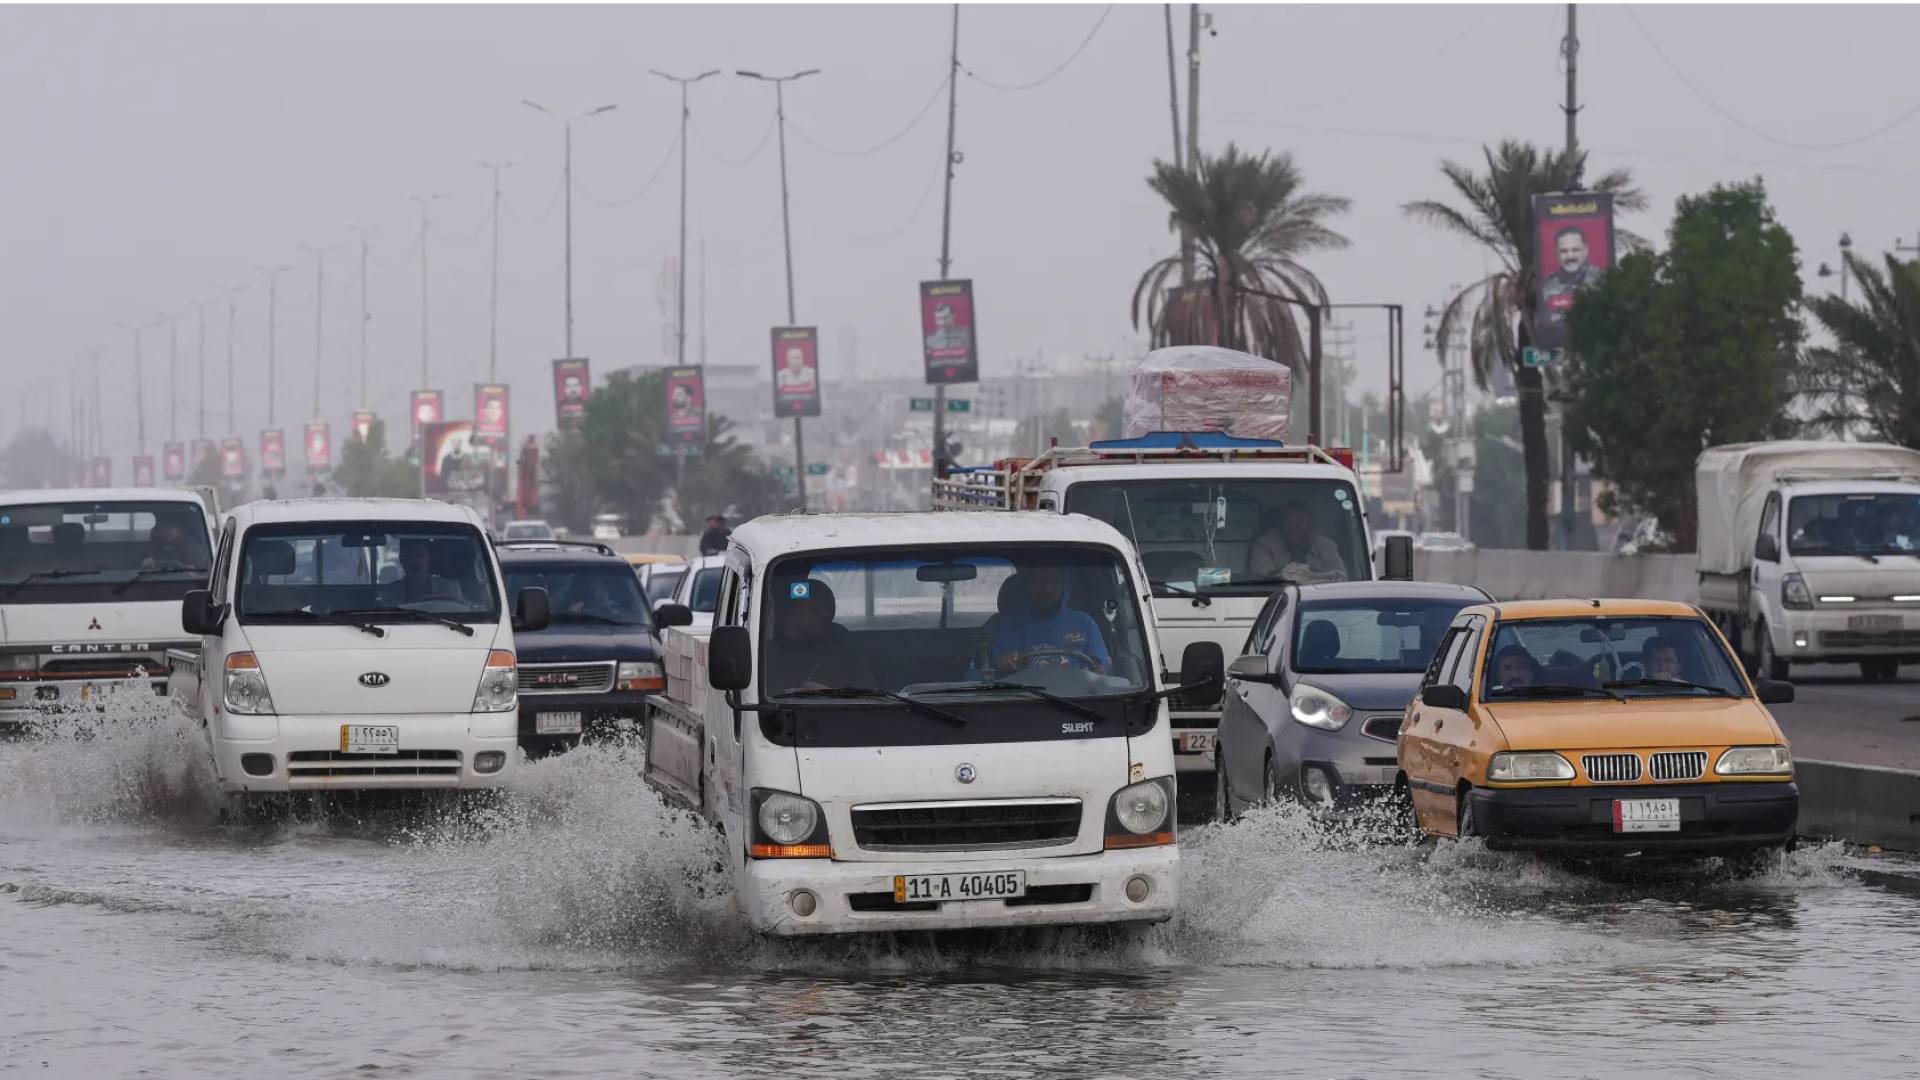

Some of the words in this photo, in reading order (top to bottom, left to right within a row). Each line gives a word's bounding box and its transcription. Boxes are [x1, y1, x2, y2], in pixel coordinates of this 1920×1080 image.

[52, 643, 149, 653] CANTER
[1062, 722, 1094, 733] SILENT
[960, 874, 1017, 896] 40405
